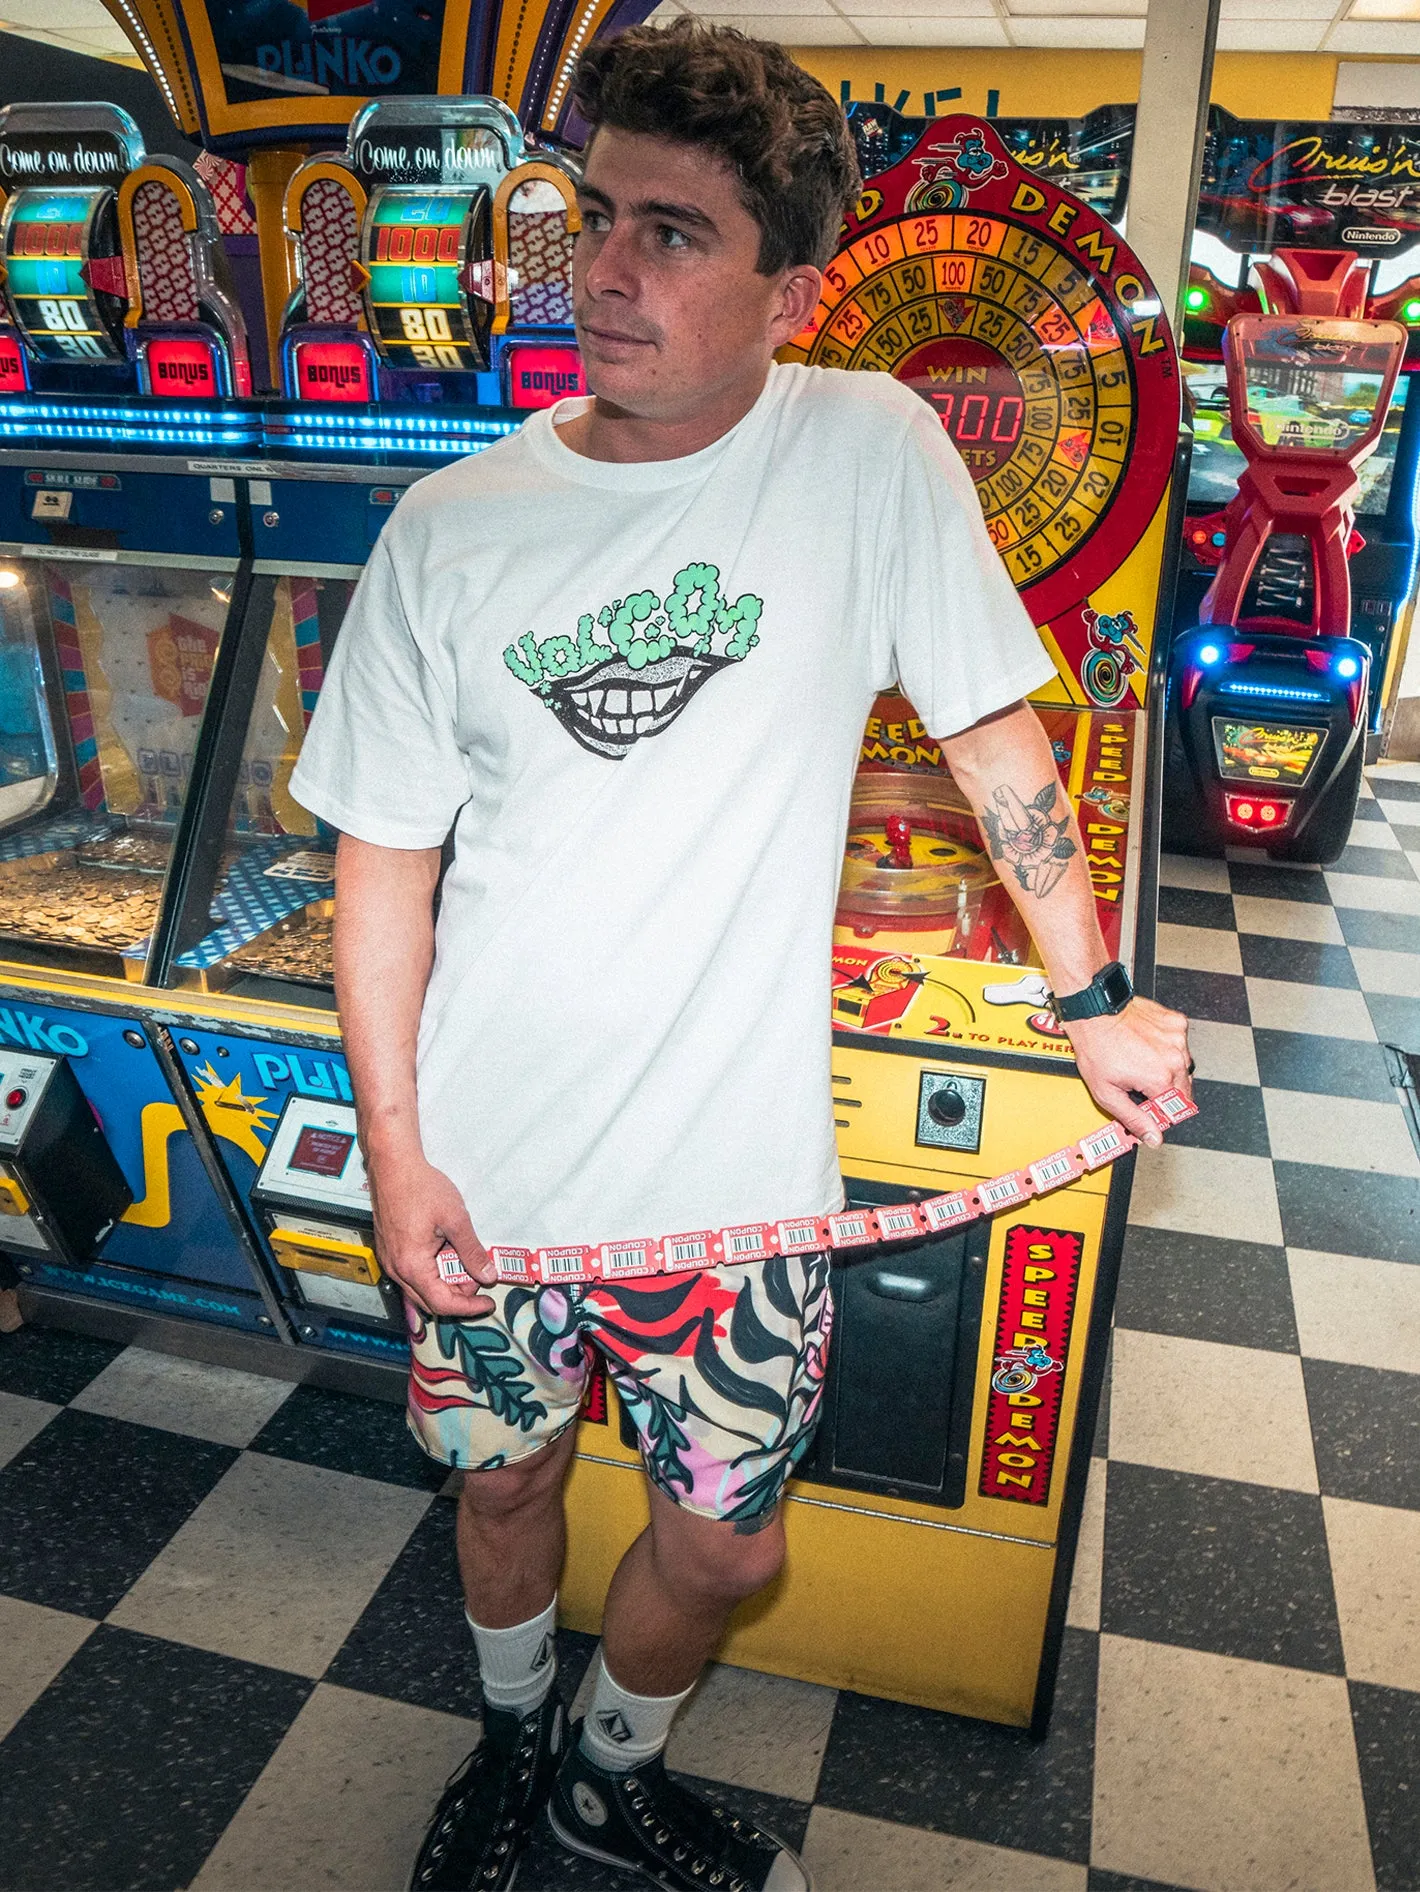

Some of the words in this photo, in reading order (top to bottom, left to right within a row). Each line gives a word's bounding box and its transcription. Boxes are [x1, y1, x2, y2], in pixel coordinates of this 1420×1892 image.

[256, 37, 401, 85] PLINKO
[0, 143, 45, 178] Come
[48, 150, 71, 173] on
[359, 139, 410, 175] Come
[415, 147, 440, 170] on
[1322, 183, 1414, 208] blast
[13, 224, 83, 256] 1000
[376, 227, 461, 261] 1000
[914, 219, 938, 247] 25
[966, 220, 992, 247] 20
[1346, 230, 1397, 242] Nintendo
[864, 234, 890, 265] 10
[1013, 234, 1042, 266] 15
[825, 267, 847, 292] 5
[902, 265, 926, 294] 50
[941, 261, 966, 286] 100
[979, 265, 1006, 295] 50
[1010, 183, 1165, 358] DEMON
[402, 267, 437, 302] 10
[864, 282, 891, 312] 75
[1014, 283, 1042, 313] 75
[38, 300, 88, 331] 80
[400, 309, 453, 341] 80
[837, 309, 863, 340] 25
[908, 306, 932, 335] 25
[979, 310, 1007, 338] 25
[1041, 313, 1071, 343] 25
[877, 327, 902, 357] 50
[1006, 332, 1034, 362] 50
[158, 362, 208, 384] BONUS
[307, 364, 361, 388] BONUS
[520, 371, 579, 396] BONUS
[927, 365, 987, 384] WIN
[1099, 420, 1125, 446] 10
[1017, 440, 1043, 466] 75
[996, 469, 1022, 497] 100
[1041, 469, 1067, 498] 20
[1084, 470, 1110, 498] 20
[1015, 498, 1041, 527] 25
[1054, 512, 1081, 541] 25
[1016, 544, 1042, 573] 15
[865, 717, 928, 743] EED
[859, 742, 941, 766] MON
[1092, 723, 1129, 782] SPEED
[832, 956, 868, 966] MON
[0, 1007, 89, 1057] NKO
[924, 1014, 951, 1037] 2
[969, 1033, 990, 1042] TO
[997, 1037, 1038, 1048] PLAY
[1042, 1042, 1074, 1053] HER
[1036, 1151, 1066, 1168] COUPON
[984, 1174, 1015, 1188] COUPON
[1044, 1172, 1076, 1188] COUPON
[883, 1207, 910, 1216] COUPON
[931, 1193, 962, 1207] COUPON
[992, 1194, 1024, 1209] COUPON
[784, 1219, 815, 1228] COUPON
[835, 1213, 864, 1221] COUPON
[940, 1213, 970, 1227] COUPON
[672, 1233, 706, 1243] COUPON
[729, 1226, 762, 1236] COUPON
[841, 1237, 870, 1245] COUPON
[890, 1229, 919, 1238] COUPON
[499, 1248, 526, 1257] COUPON
[548, 1248, 583, 1257] COUPON
[609, 1241, 646, 1251] COUPON
[734, 1251, 766, 1261] COUPON
[789, 1244, 820, 1253] COUPON
[503, 1273, 528, 1282] COUPON
[550, 1274, 586, 1282] COUPON
[611, 1268, 649, 1278] COUPON
[674, 1260, 709, 1270] COUPON
[1013, 1244, 1056, 1349] SPEED
[994, 1393, 1043, 1489] DEMON
